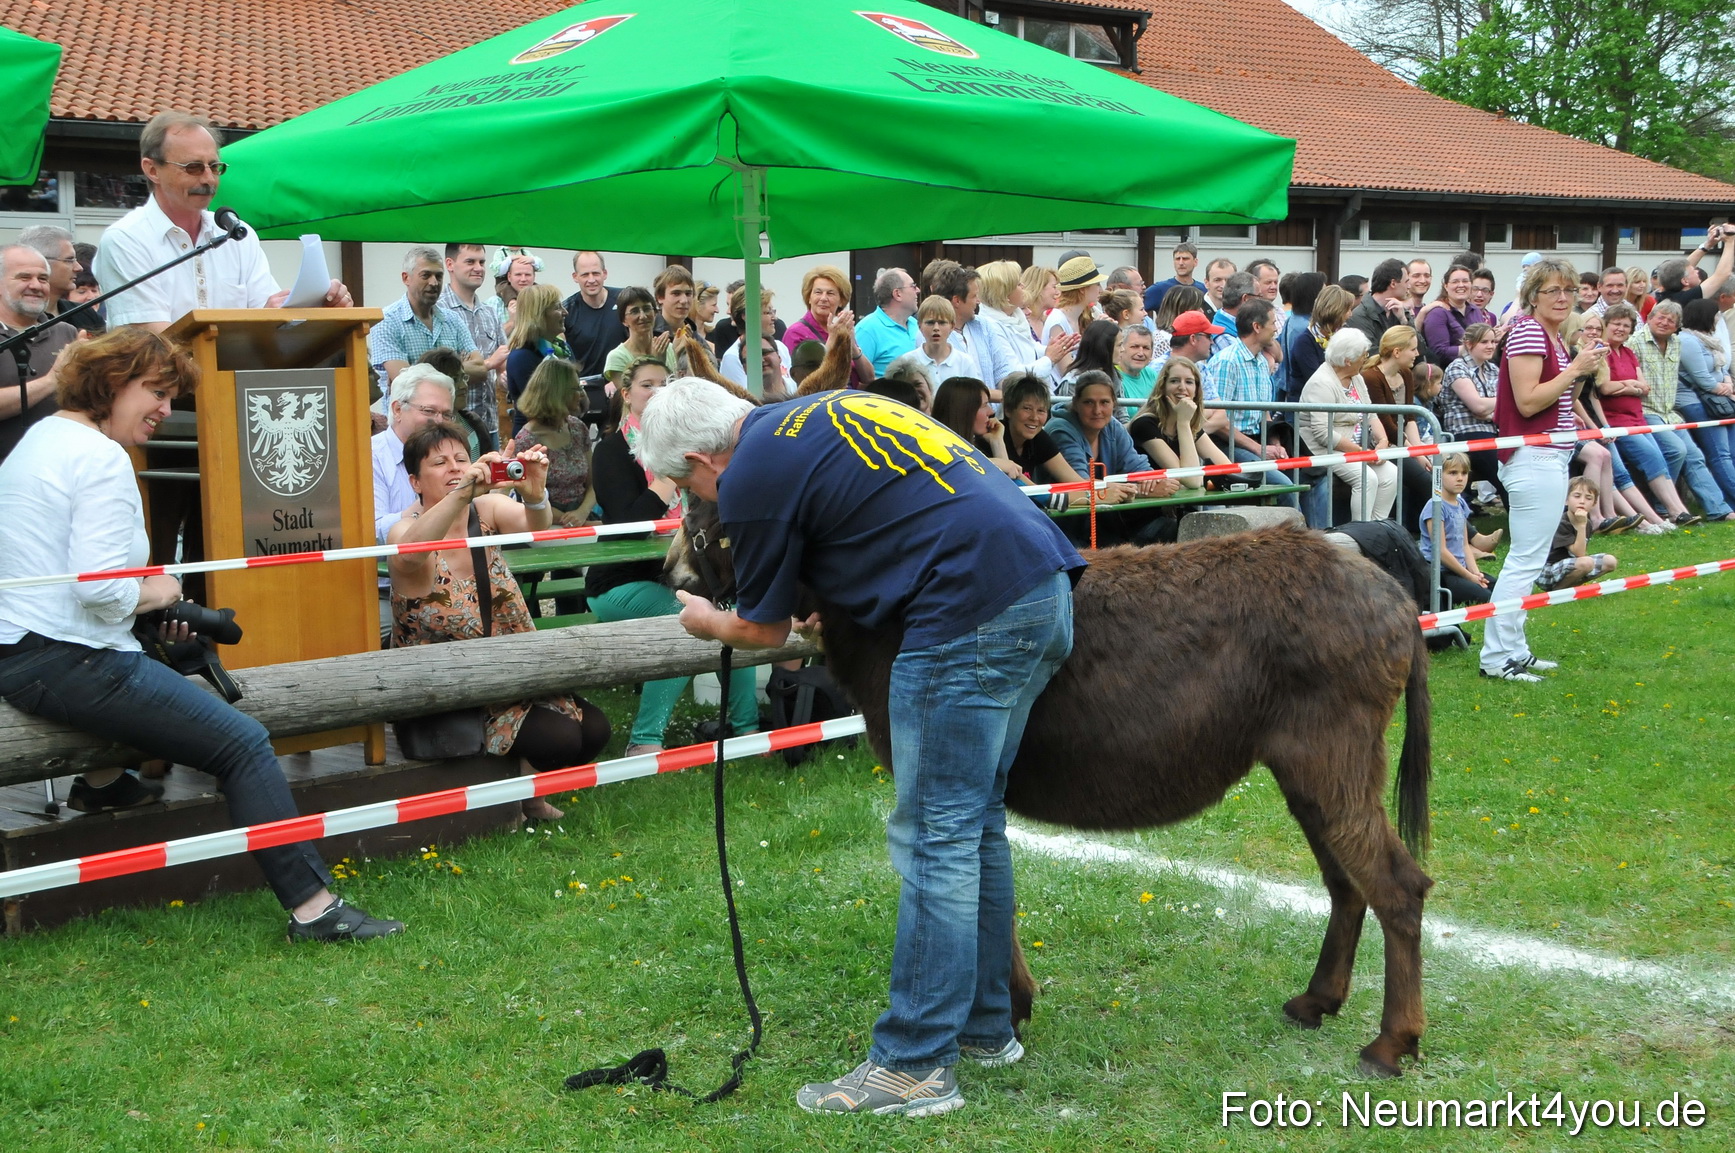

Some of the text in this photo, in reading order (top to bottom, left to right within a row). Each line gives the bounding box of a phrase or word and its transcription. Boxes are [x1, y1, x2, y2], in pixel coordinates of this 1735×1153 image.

[414, 64, 586, 99] Neumarkter
[894, 57, 1075, 90] Neumarkter
[345, 79, 579, 126] Lammsbräu
[887, 71, 1146, 116] Lammsbräu
[785, 402, 821, 438] Rathaus
[273, 507, 314, 532] Stadt
[255, 532, 333, 556] Neumarkt
